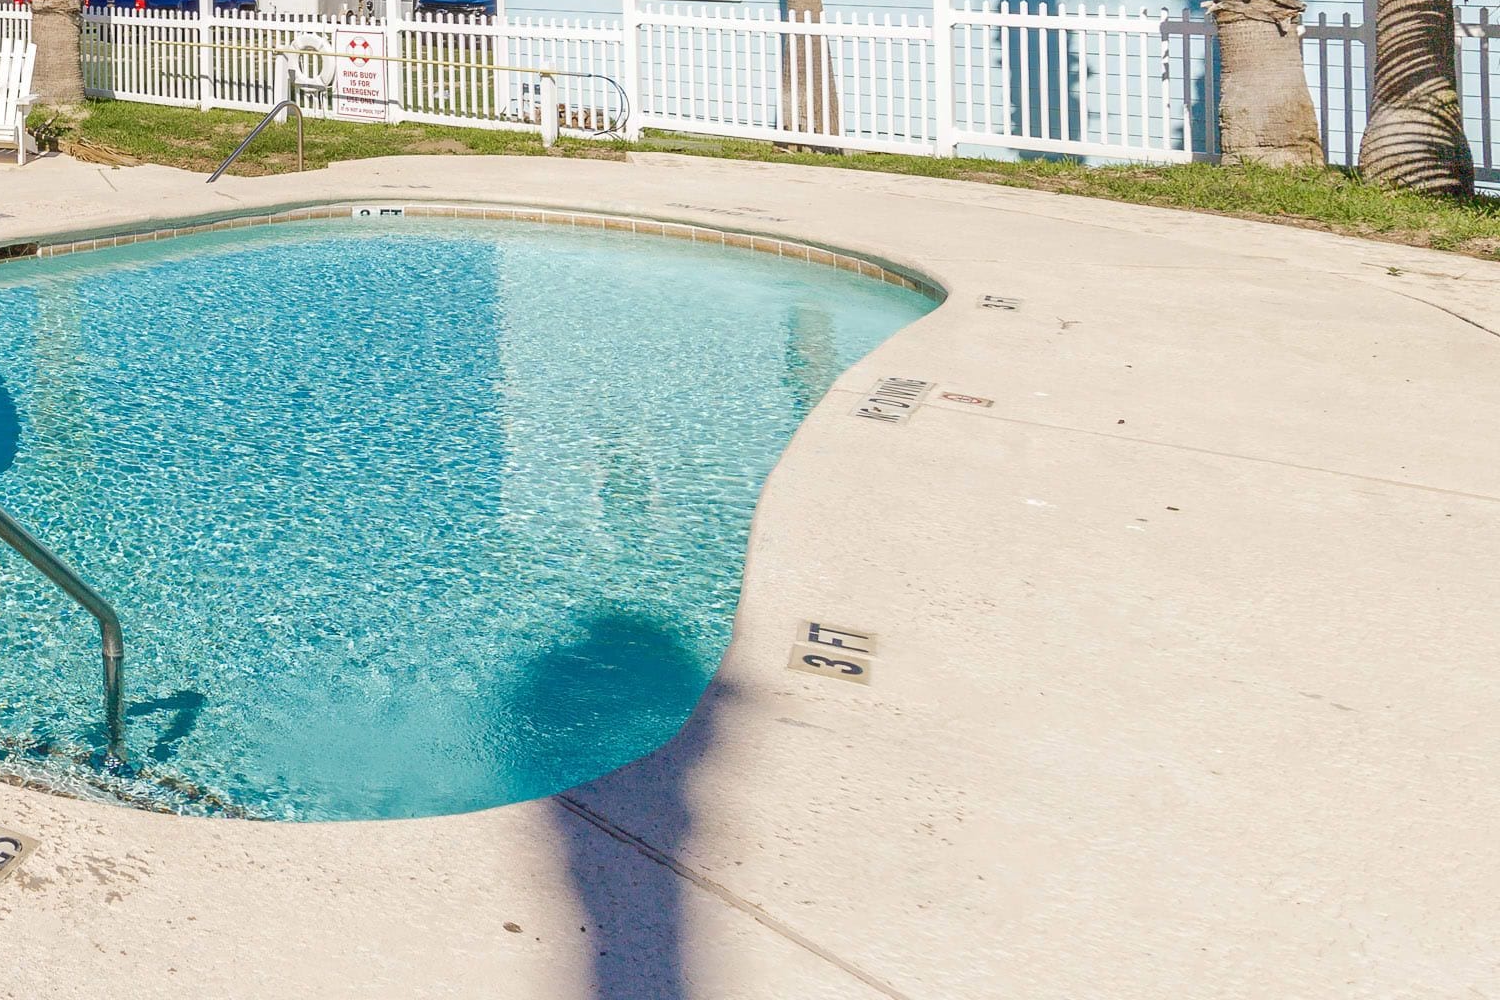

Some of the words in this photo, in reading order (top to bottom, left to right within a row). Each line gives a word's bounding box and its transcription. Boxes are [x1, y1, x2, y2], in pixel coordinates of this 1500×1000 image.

[343, 88, 379, 96] EMERGENCY
[868, 377, 927, 409] DIVING
[808, 622, 869, 653] FT
[802, 654, 863, 675] 3
